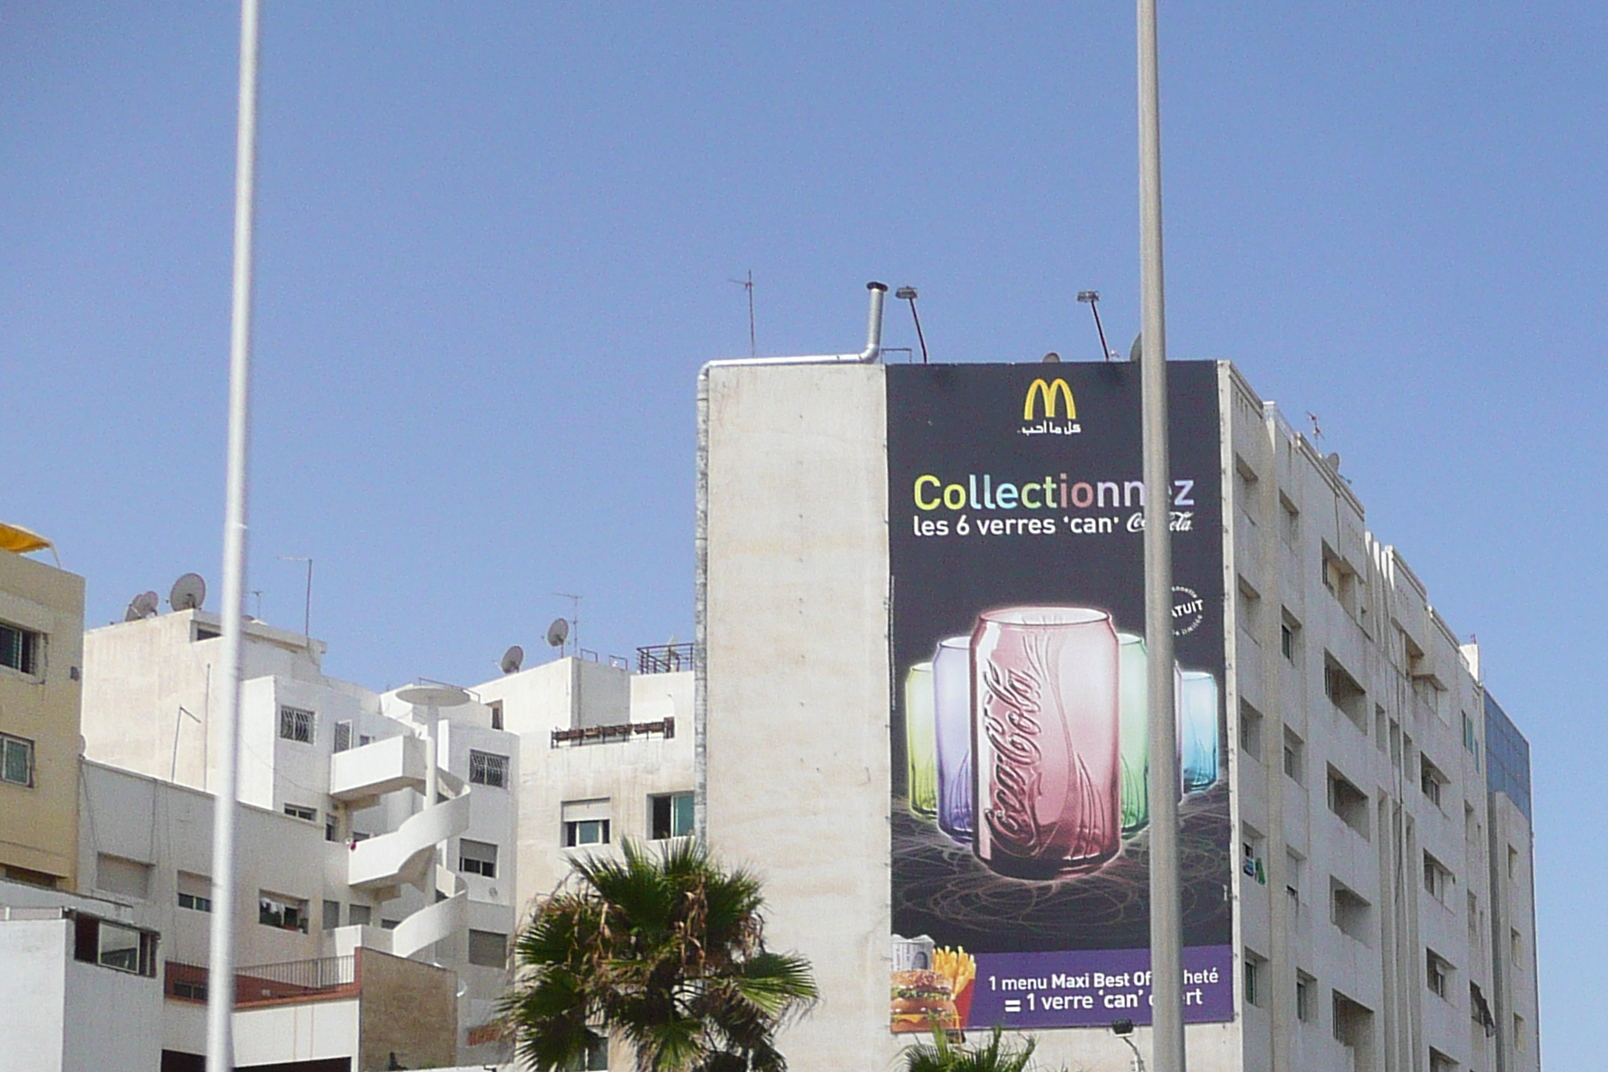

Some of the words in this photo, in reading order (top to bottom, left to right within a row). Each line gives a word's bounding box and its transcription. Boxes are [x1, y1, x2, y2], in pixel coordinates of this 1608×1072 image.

[1048, 420, 1063, 435] ما
[1063, 420, 1082, 435] كل
[914, 473, 1195, 511] Collectionnz
[913, 515, 949, 537] les
[956, 515, 970, 536] 6
[977, 517, 1056, 536] verres
[988, 975, 996, 991] 1
[1001, 976, 1048, 991] menu
[1051, 973, 1090, 989] Maxi
[1093, 972, 1130, 988] Best
[1133, 970, 1153, 987] Of
[1183, 966, 1219, 985] heté
[1026, 993, 1035, 1011] 1
[1041, 994, 1094, 1010] verre
